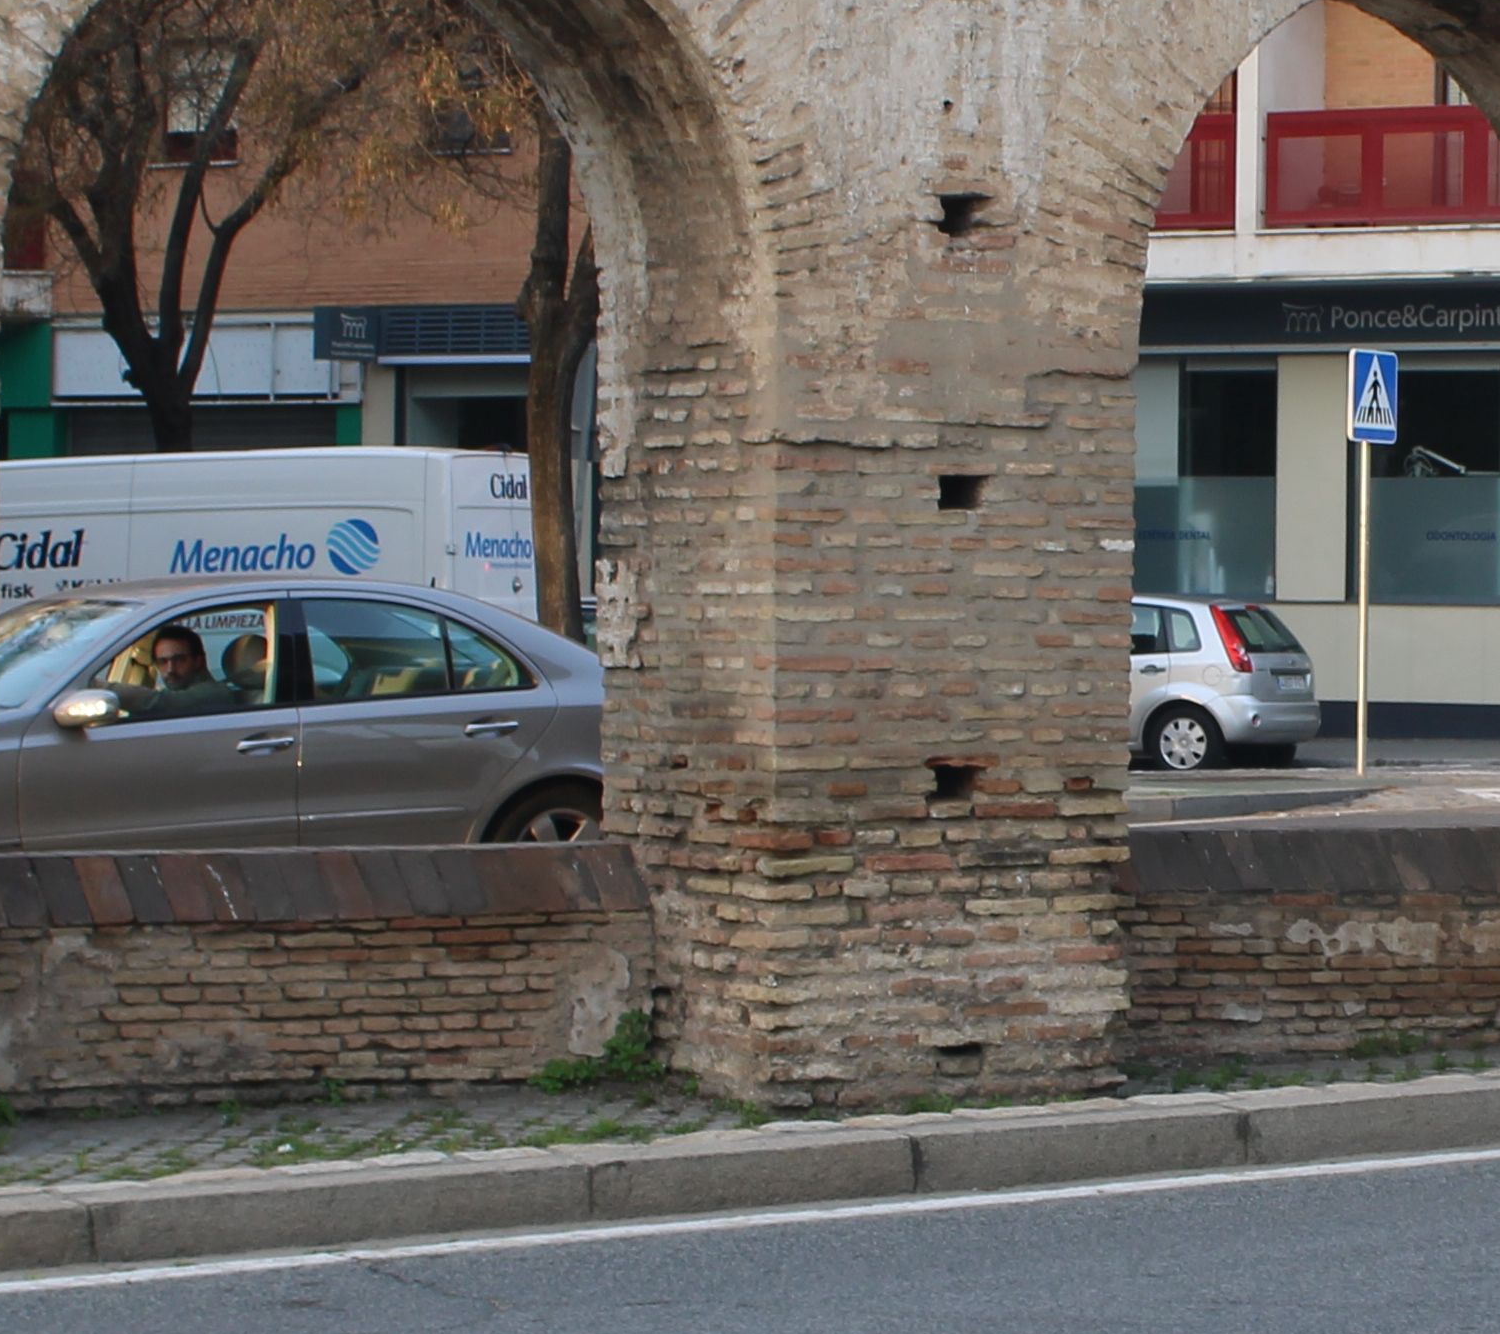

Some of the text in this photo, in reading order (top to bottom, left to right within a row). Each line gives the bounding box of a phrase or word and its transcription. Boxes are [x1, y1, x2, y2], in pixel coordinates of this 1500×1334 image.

[489, 473, 528, 500] Cidal
[169, 532, 316, 575] Menacho
[465, 530, 533, 559] Menacho
[204, 613, 266, 631] LIMPIEZA
